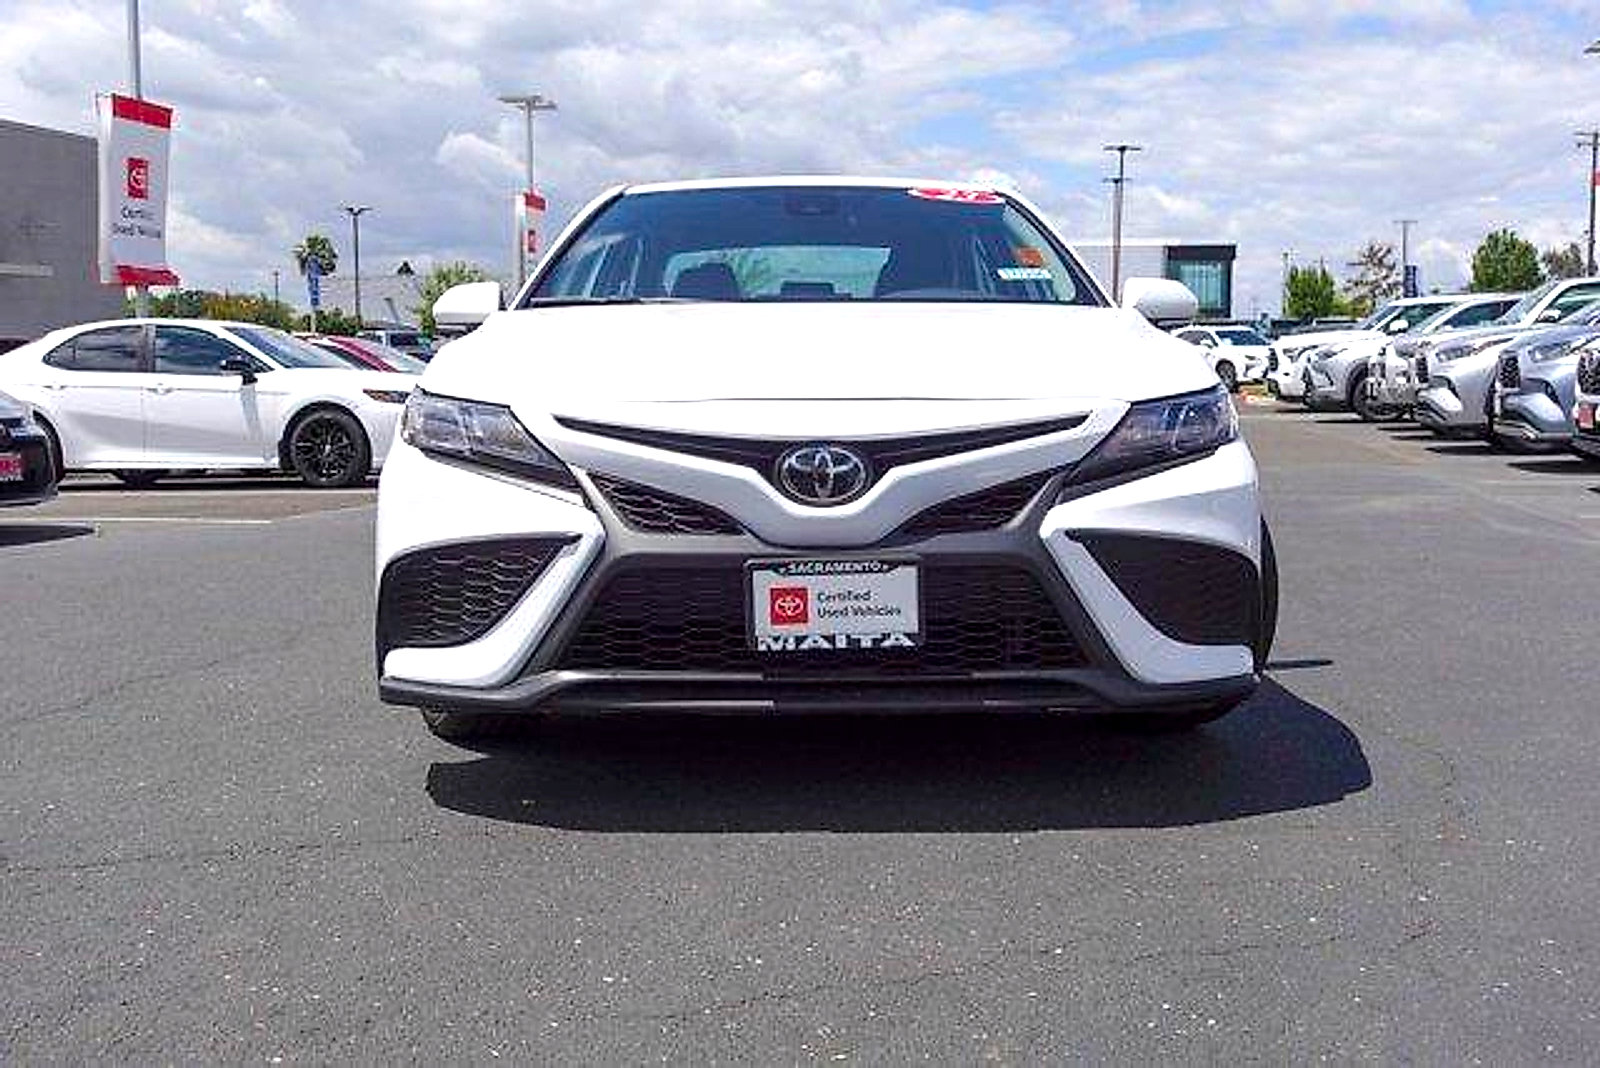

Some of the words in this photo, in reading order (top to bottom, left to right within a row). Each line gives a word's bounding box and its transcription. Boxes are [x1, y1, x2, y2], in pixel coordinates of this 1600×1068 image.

[787, 561, 881, 574] SACRAMENTO
[817, 589, 871, 601] Certified
[817, 606, 849, 617] Used
[850, 604, 902, 617] Vehicles
[757, 633, 916, 651] MAITA
